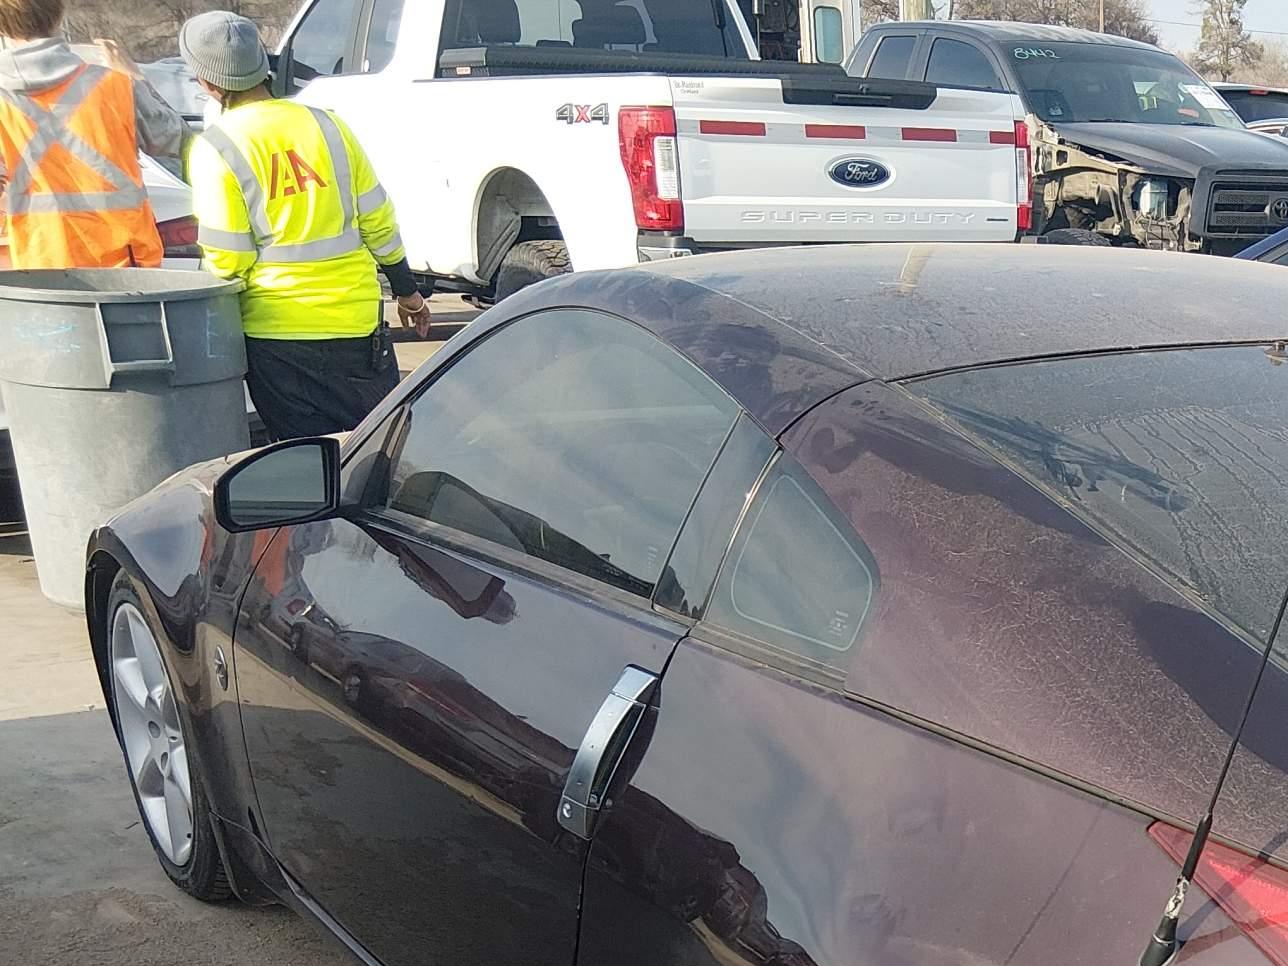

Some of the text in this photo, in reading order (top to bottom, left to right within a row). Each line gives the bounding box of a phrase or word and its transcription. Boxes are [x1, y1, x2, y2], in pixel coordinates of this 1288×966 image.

[1014, 47, 1062, 60] 8442
[844, 162, 878, 182] Ford
[740, 211, 976, 224] SUPER DUTY
